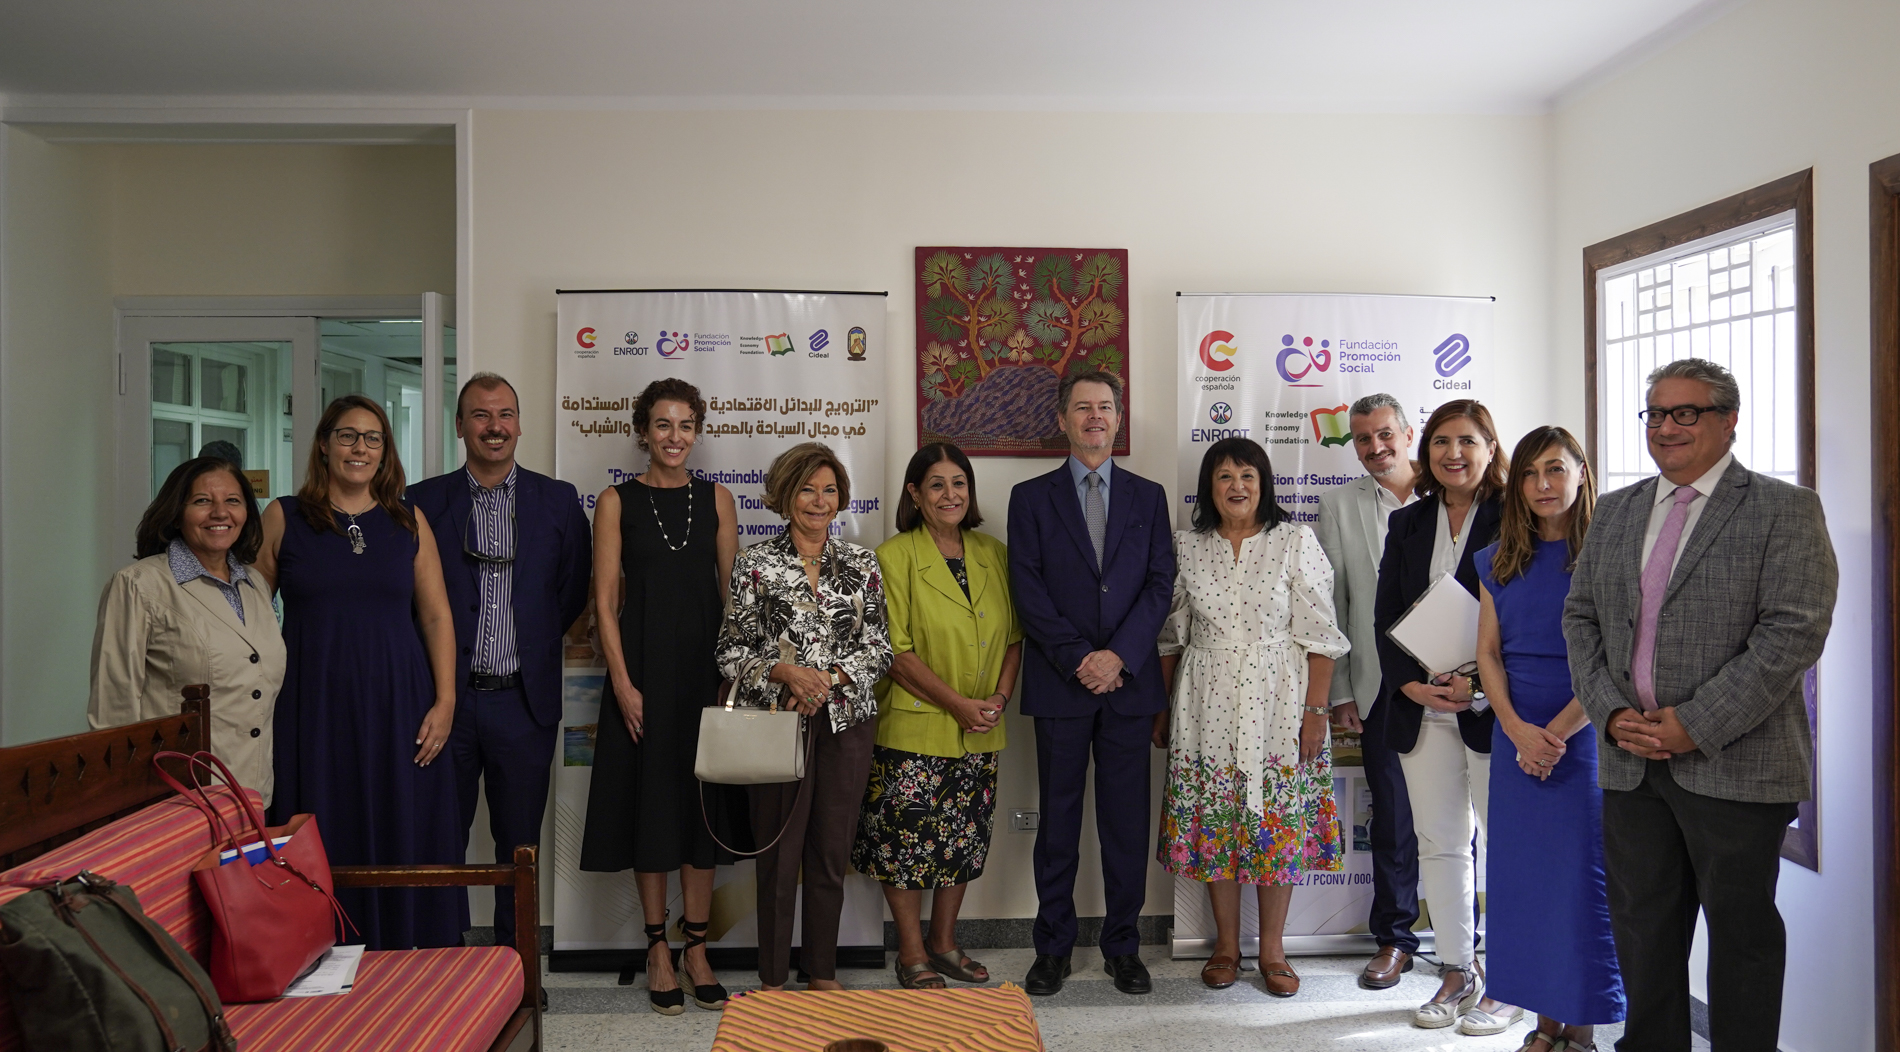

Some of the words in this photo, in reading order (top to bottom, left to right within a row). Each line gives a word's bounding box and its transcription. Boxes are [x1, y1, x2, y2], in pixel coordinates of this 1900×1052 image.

[1339, 339, 1398, 350] Fundación
[613, 347, 649, 356] ENROOT
[1339, 351, 1401, 362] Promoción
[1339, 363, 1375, 373] Social
[1195, 375, 1241, 384] cooperación
[1433, 379, 1471, 390] Cideal
[1201, 383, 1235, 391] española
[562, 396, 629, 411] المستدامة
[709, 396, 777, 414] الاقتصادية
[779, 397, 822, 415] للبدائل
[1265, 411, 1308, 419] Knowledge
[706, 422, 753, 438] بالصعيد
[756, 420, 805, 438] السياحة
[808, 421, 839, 438] مجال
[842, 422, 866, 439] في
[1265, 424, 1300, 433] Economy
[1191, 428, 1250, 442] ENROOT
[1296, 474, 1309, 486] of
[1313, 873, 1346, 886] PCONV
